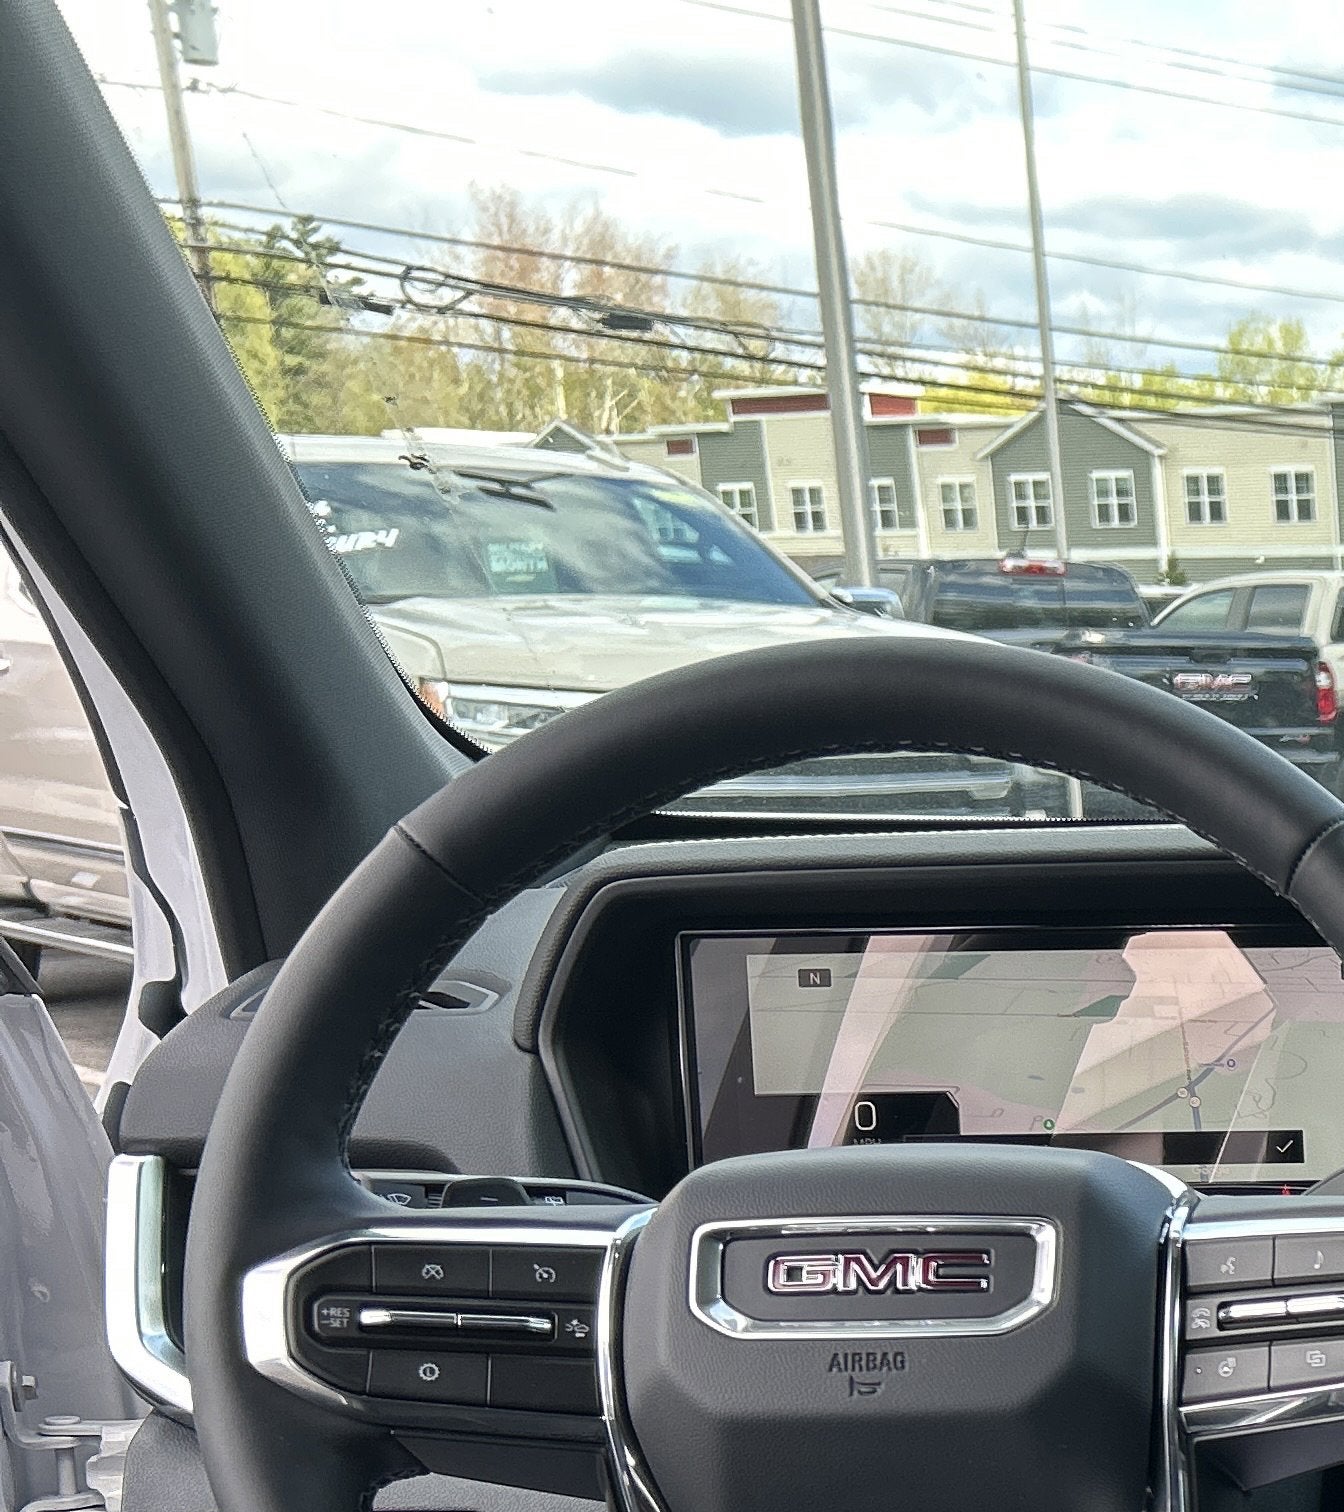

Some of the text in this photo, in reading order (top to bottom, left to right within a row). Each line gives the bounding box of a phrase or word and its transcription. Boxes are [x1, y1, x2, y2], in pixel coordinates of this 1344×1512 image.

[809, 971, 821, 985] N
[855, 1102, 877, 1130] 0
[768, 1252, 991, 1293] GMC
[828, 1351, 906, 1372] AIRBAG
